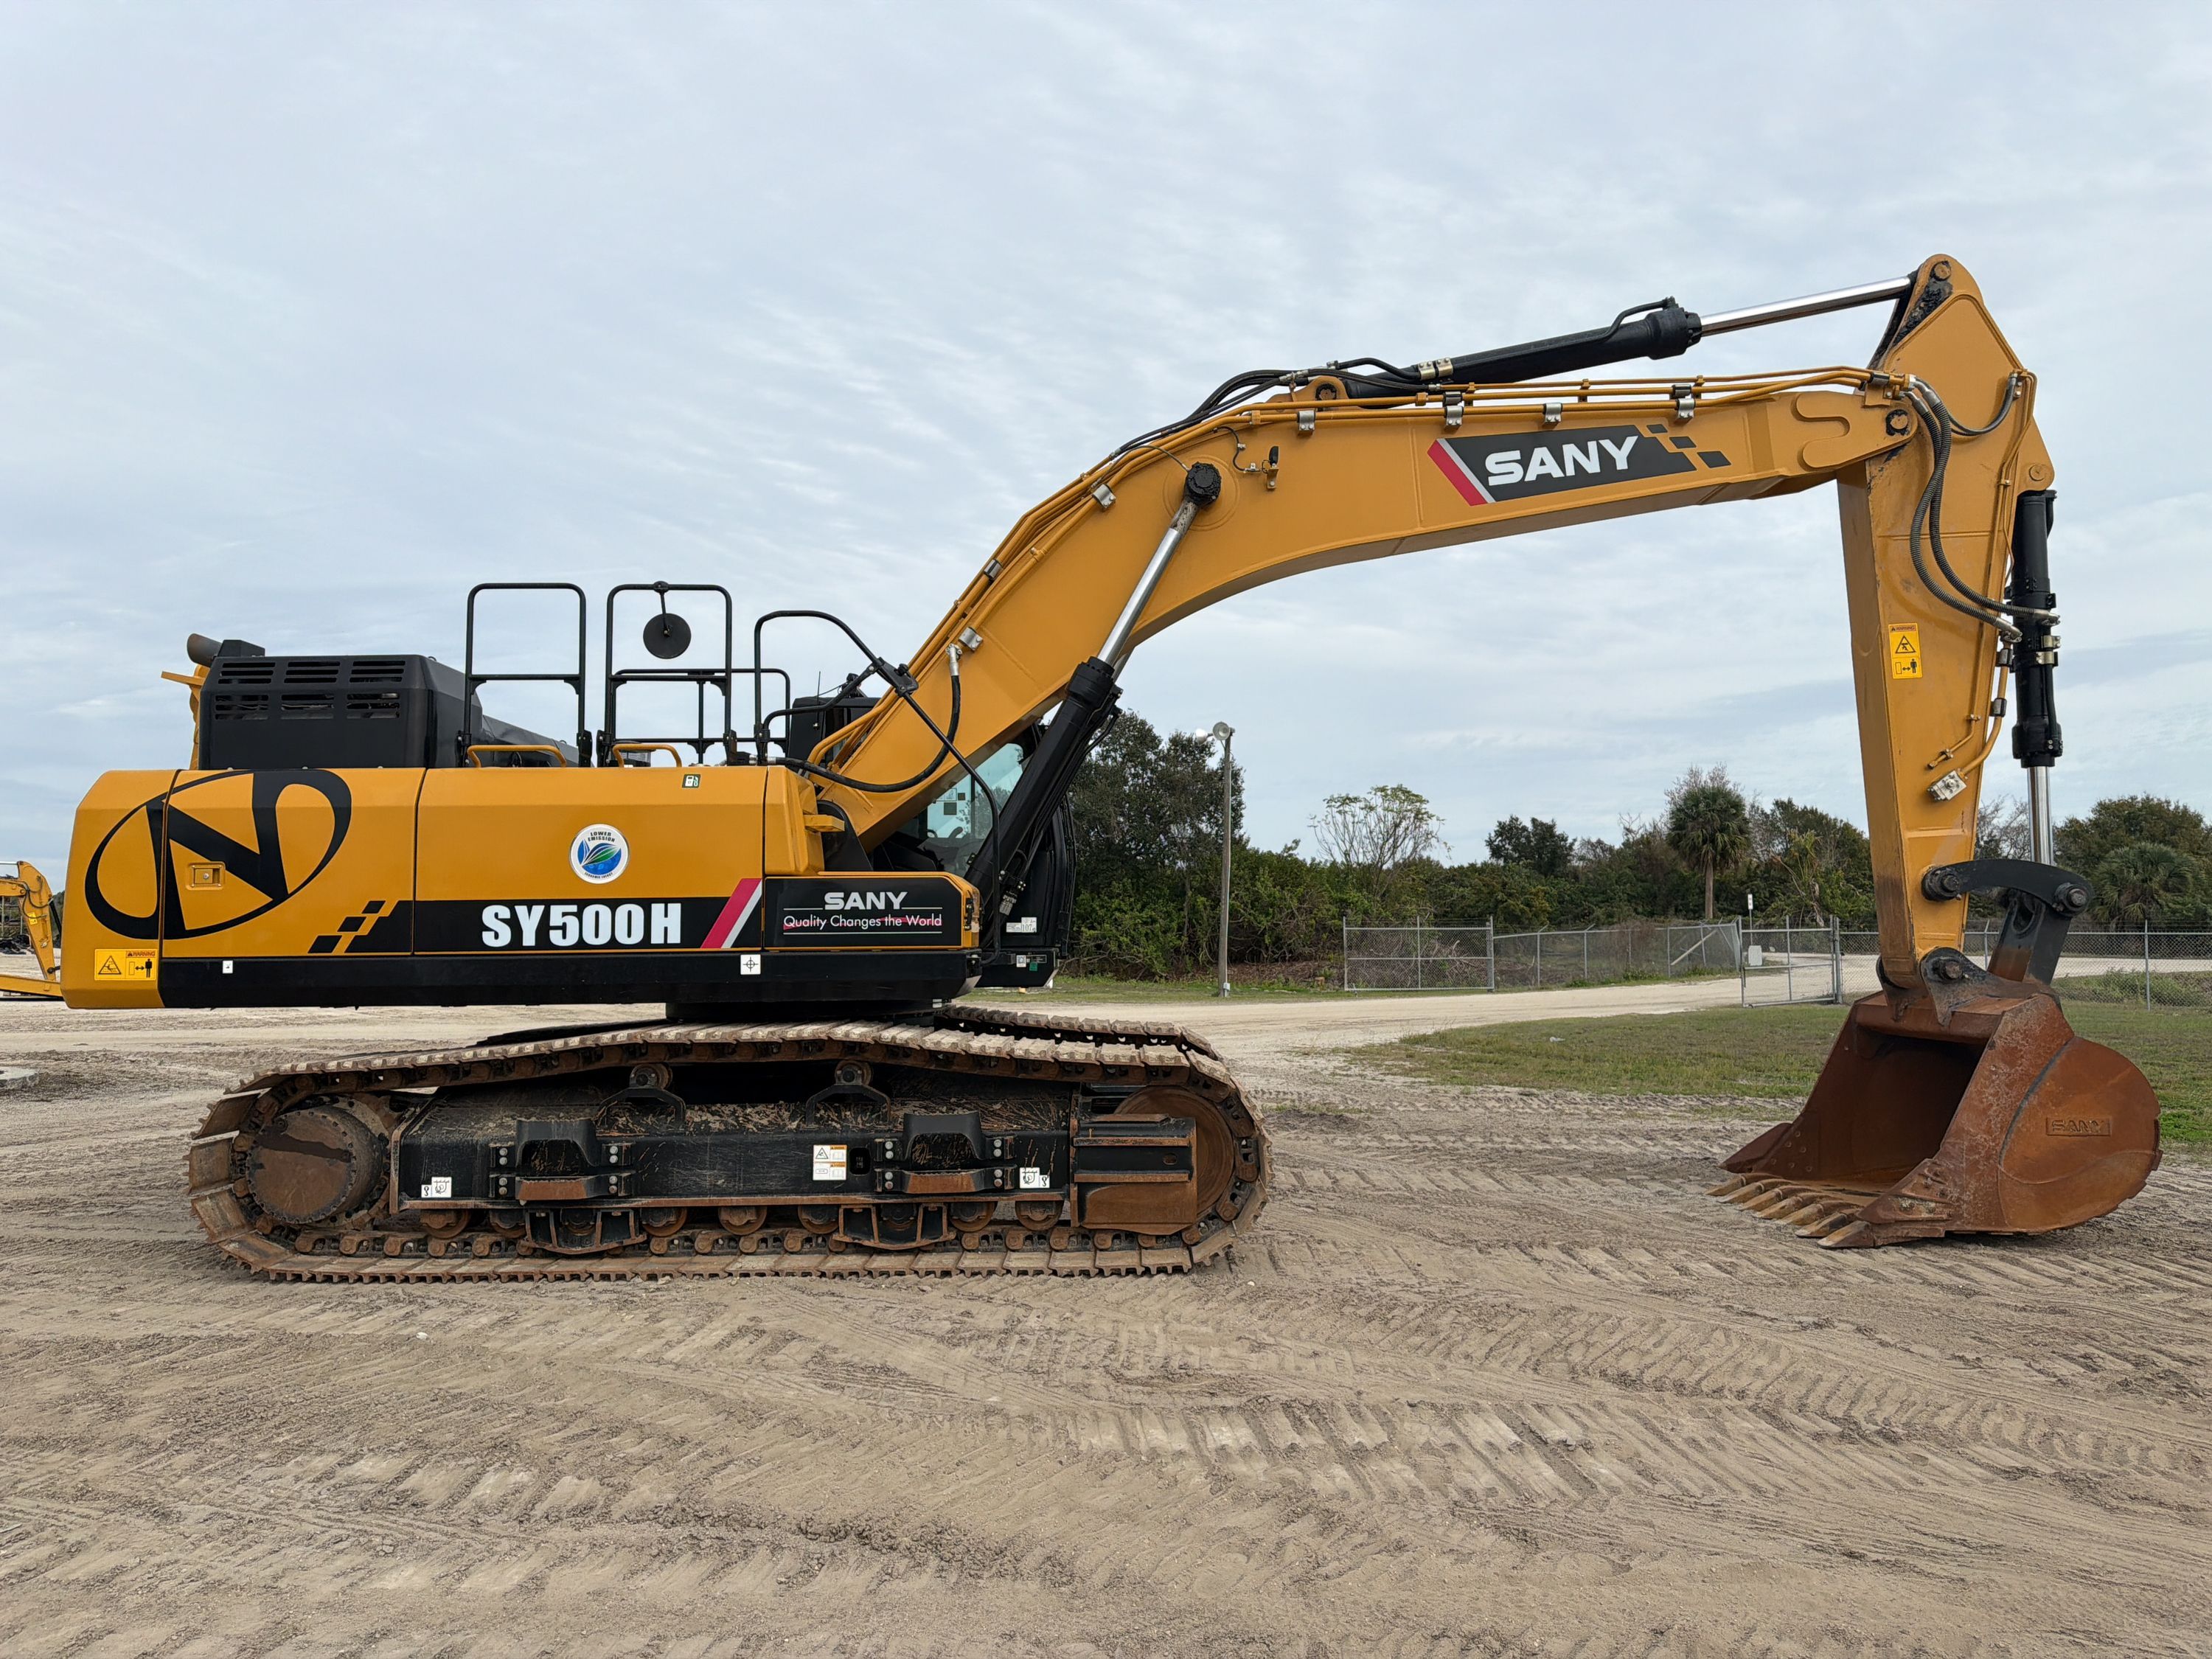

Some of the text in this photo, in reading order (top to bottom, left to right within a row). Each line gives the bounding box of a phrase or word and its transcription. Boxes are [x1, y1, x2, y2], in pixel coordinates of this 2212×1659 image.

[1485, 435, 1638, 486] SANY
[824, 891, 908, 910] SANY
[481, 902, 681, 947] SY500H
[783, 913, 942, 930] Quality Changes the World
[2052, 1119, 2104, 1133] SANY
